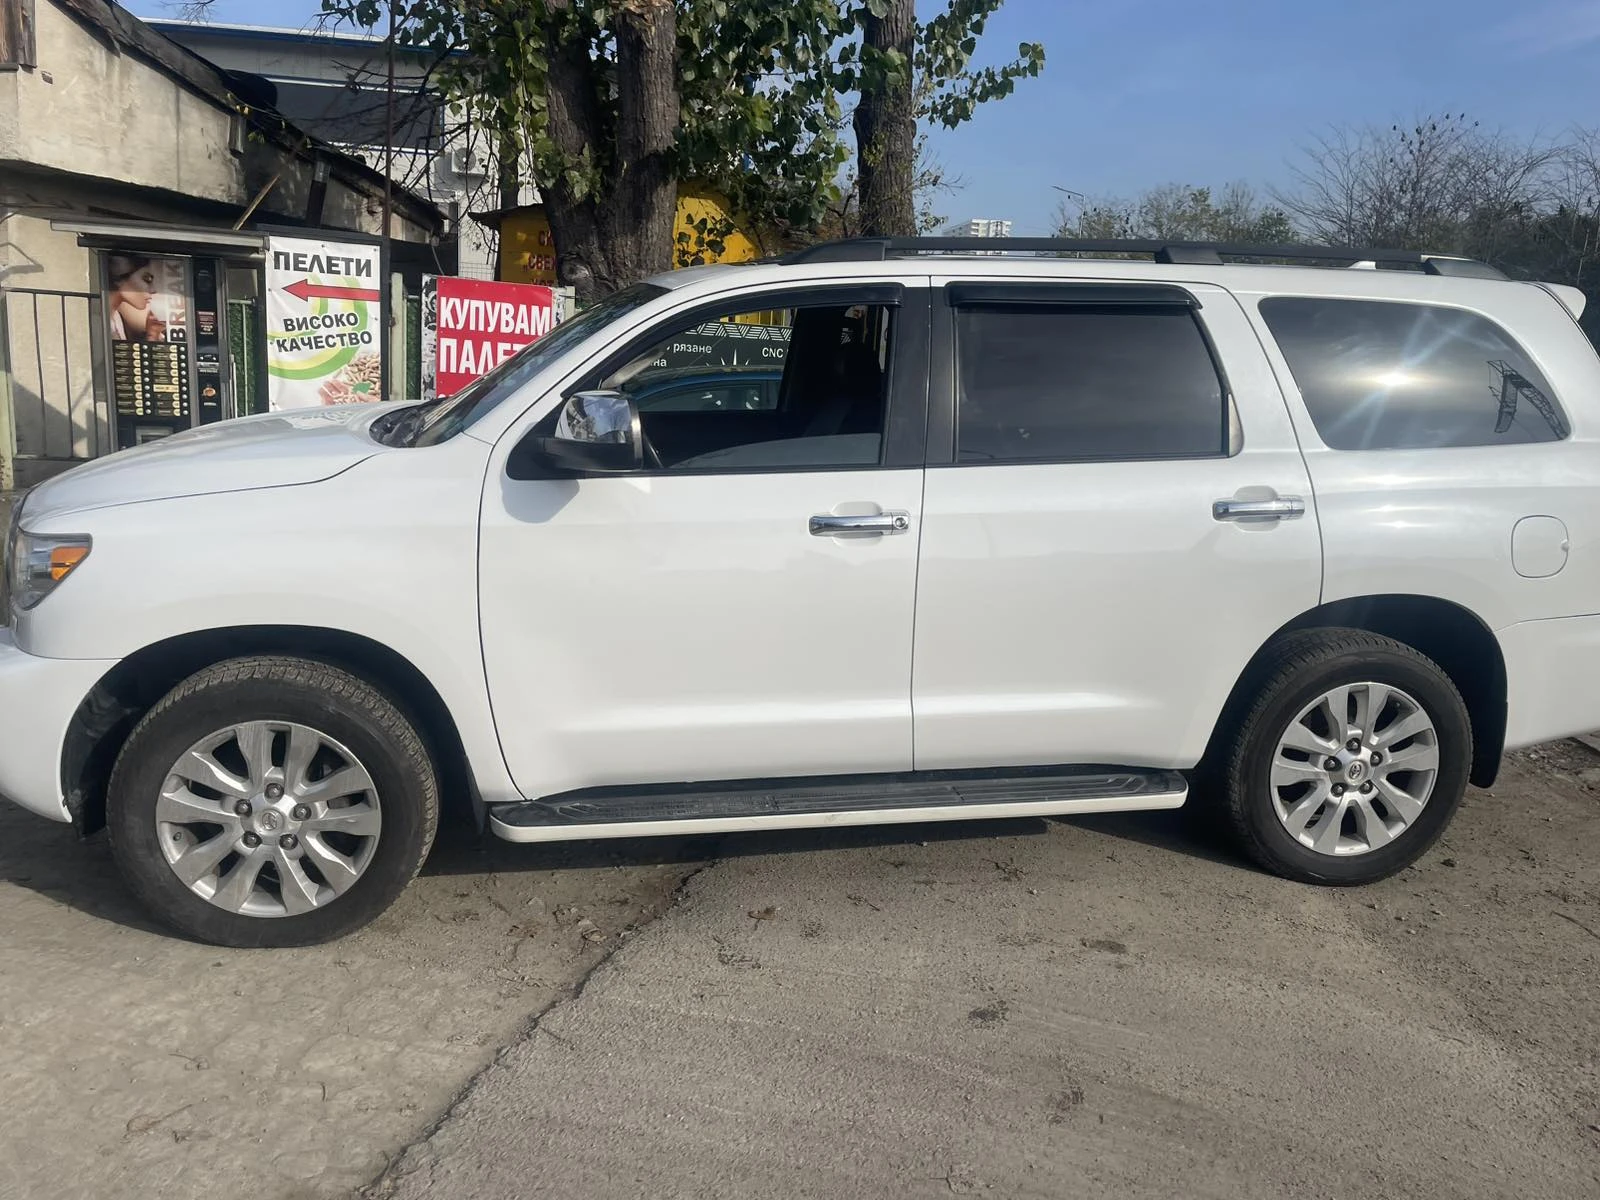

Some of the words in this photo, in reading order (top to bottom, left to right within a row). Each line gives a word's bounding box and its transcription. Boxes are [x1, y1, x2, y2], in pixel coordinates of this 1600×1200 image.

[273, 250, 372, 277] ПЕЛЕТИ
[168, 259, 186, 342] BREAK
[283, 312, 359, 332] ВИСОКО
[439, 296, 551, 336] КУПУВАМ
[276, 331, 373, 353] КАЧЕСТВО
[673, 343, 712, 354] рязане
[762, 347, 784, 358] CNC
